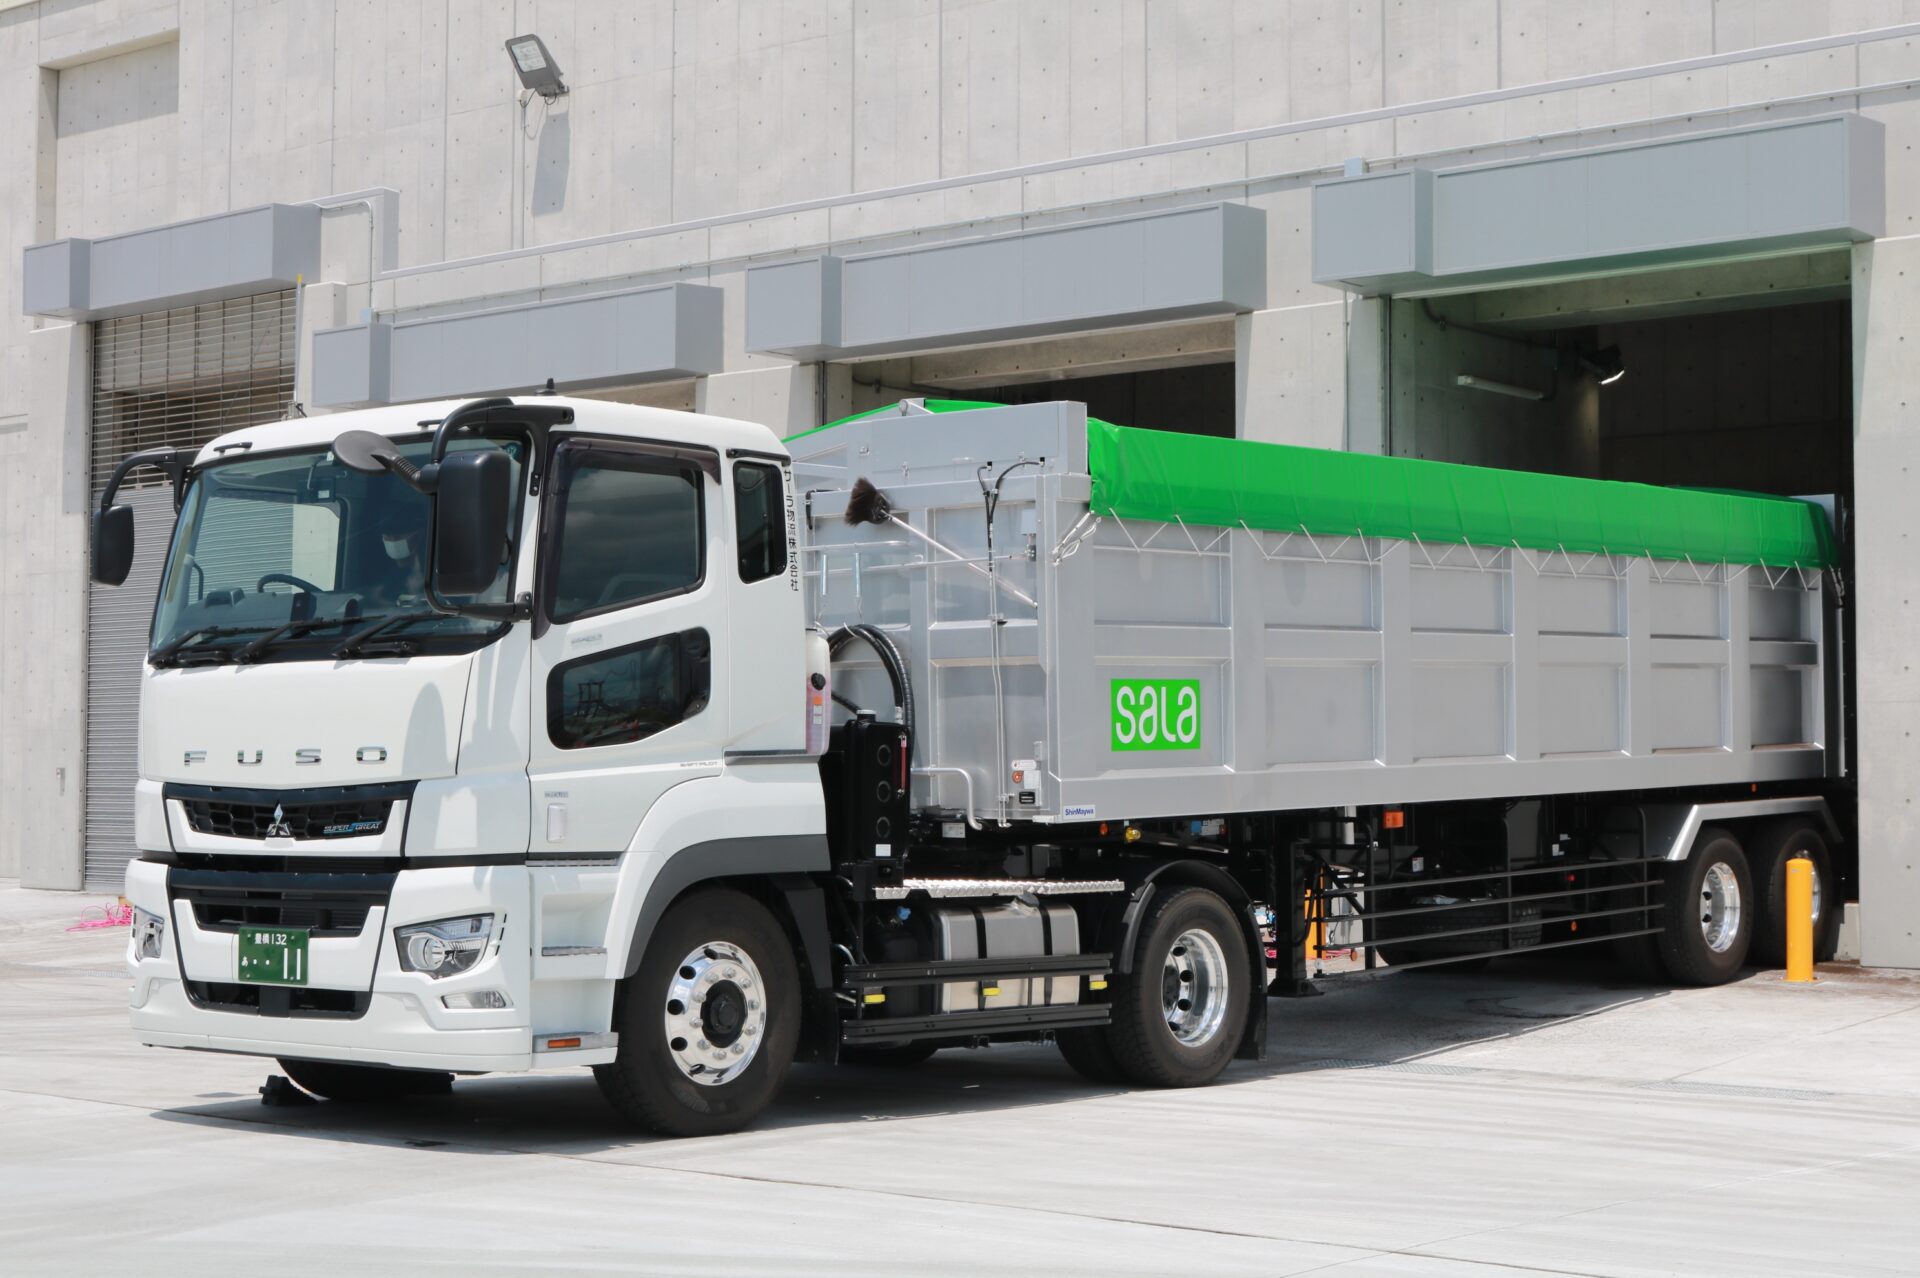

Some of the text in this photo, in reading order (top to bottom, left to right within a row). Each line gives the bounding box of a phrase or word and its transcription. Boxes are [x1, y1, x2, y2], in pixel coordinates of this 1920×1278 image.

[783, 470, 799, 591] サーラ物流株式会社
[184, 746, 388, 767] FUSO
[1065, 808, 1094, 816] ShinMaywa
